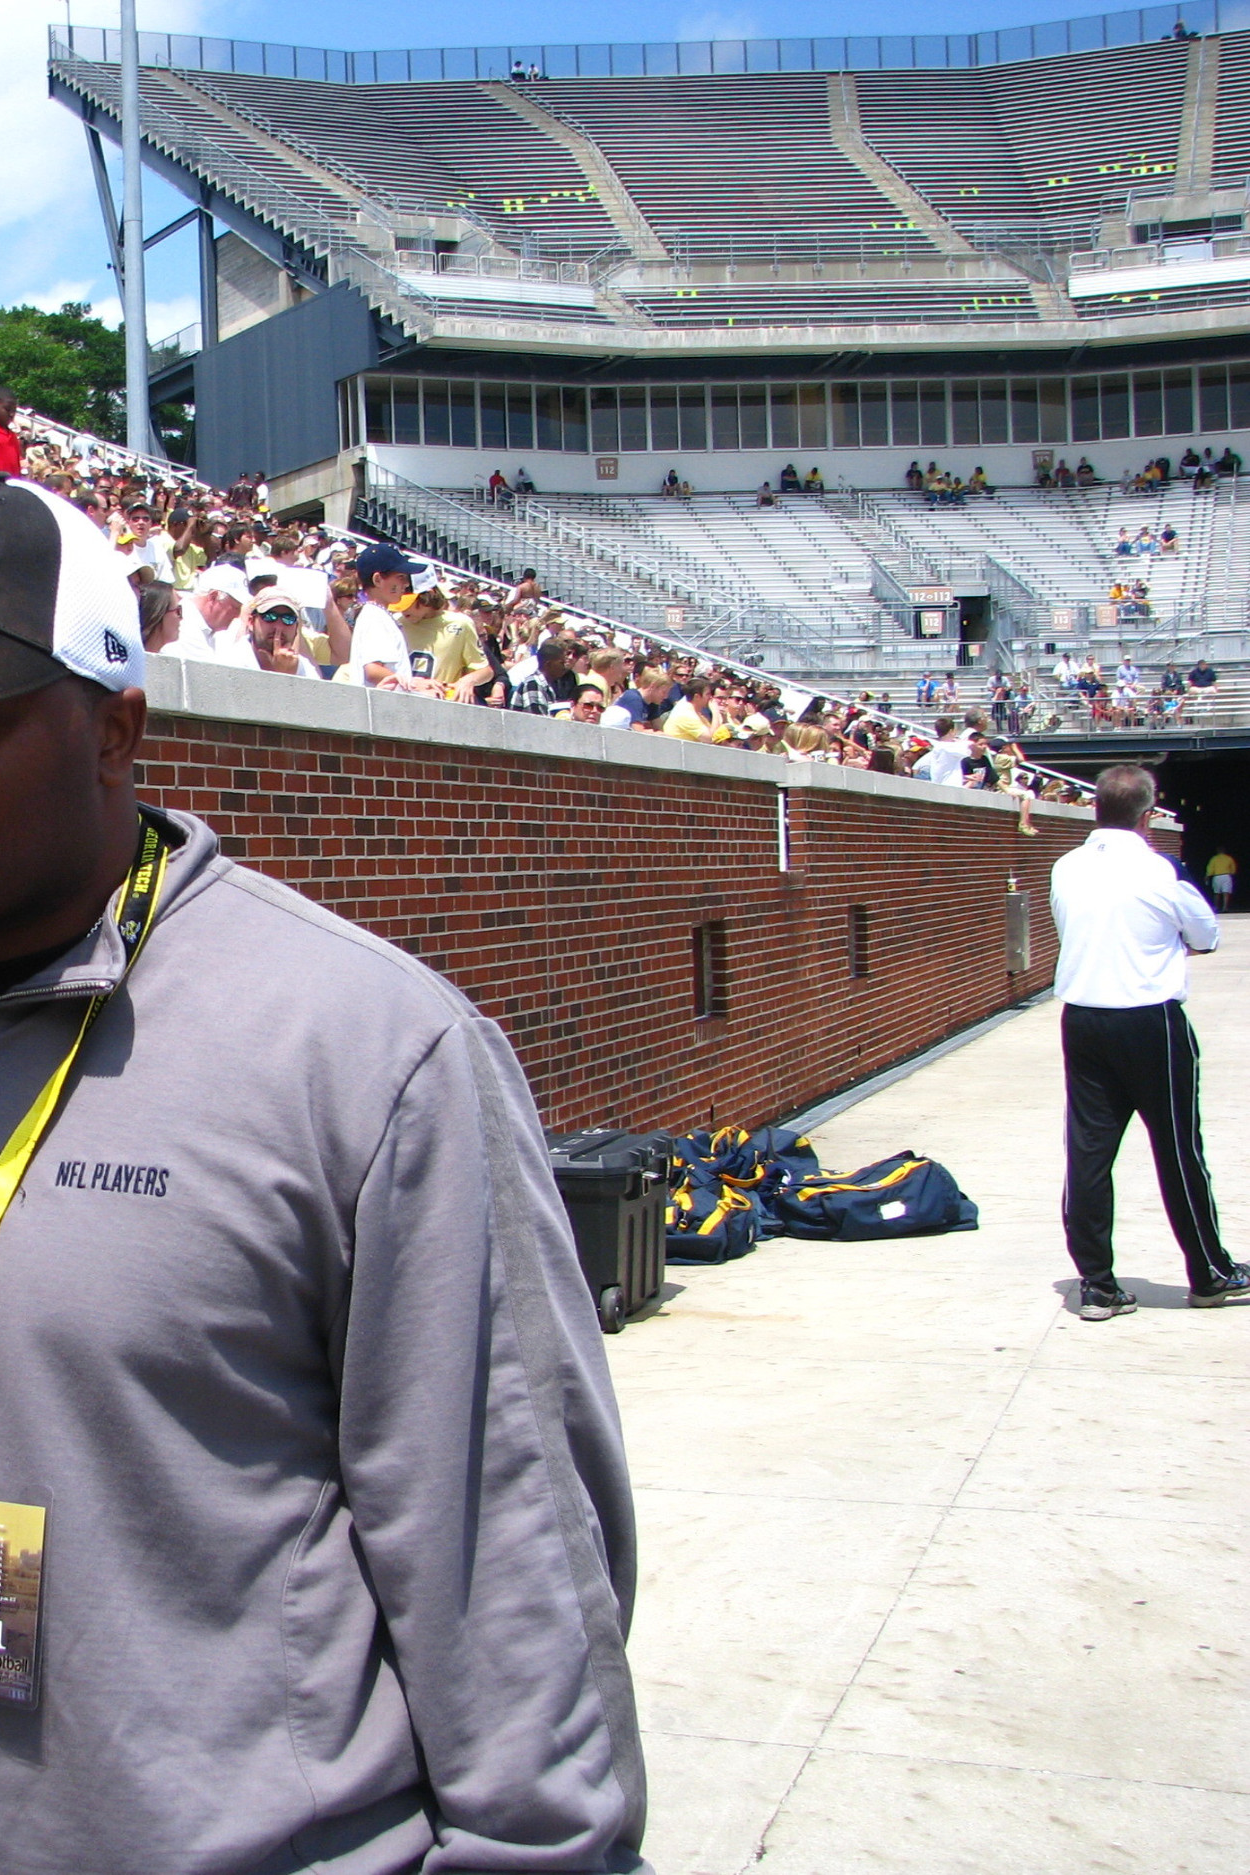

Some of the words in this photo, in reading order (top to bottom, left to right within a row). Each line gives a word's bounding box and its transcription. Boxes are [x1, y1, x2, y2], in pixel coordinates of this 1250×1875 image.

[600, 466, 615, 475] 112
[667, 614, 680, 622] 112
[924, 618, 939, 626] 112
[1053, 615, 1069, 624] 113
[133, 863, 153, 893] TECH
[55, 1161, 86, 1189] NFL
[91, 1163, 169, 1197] PLAYERS
